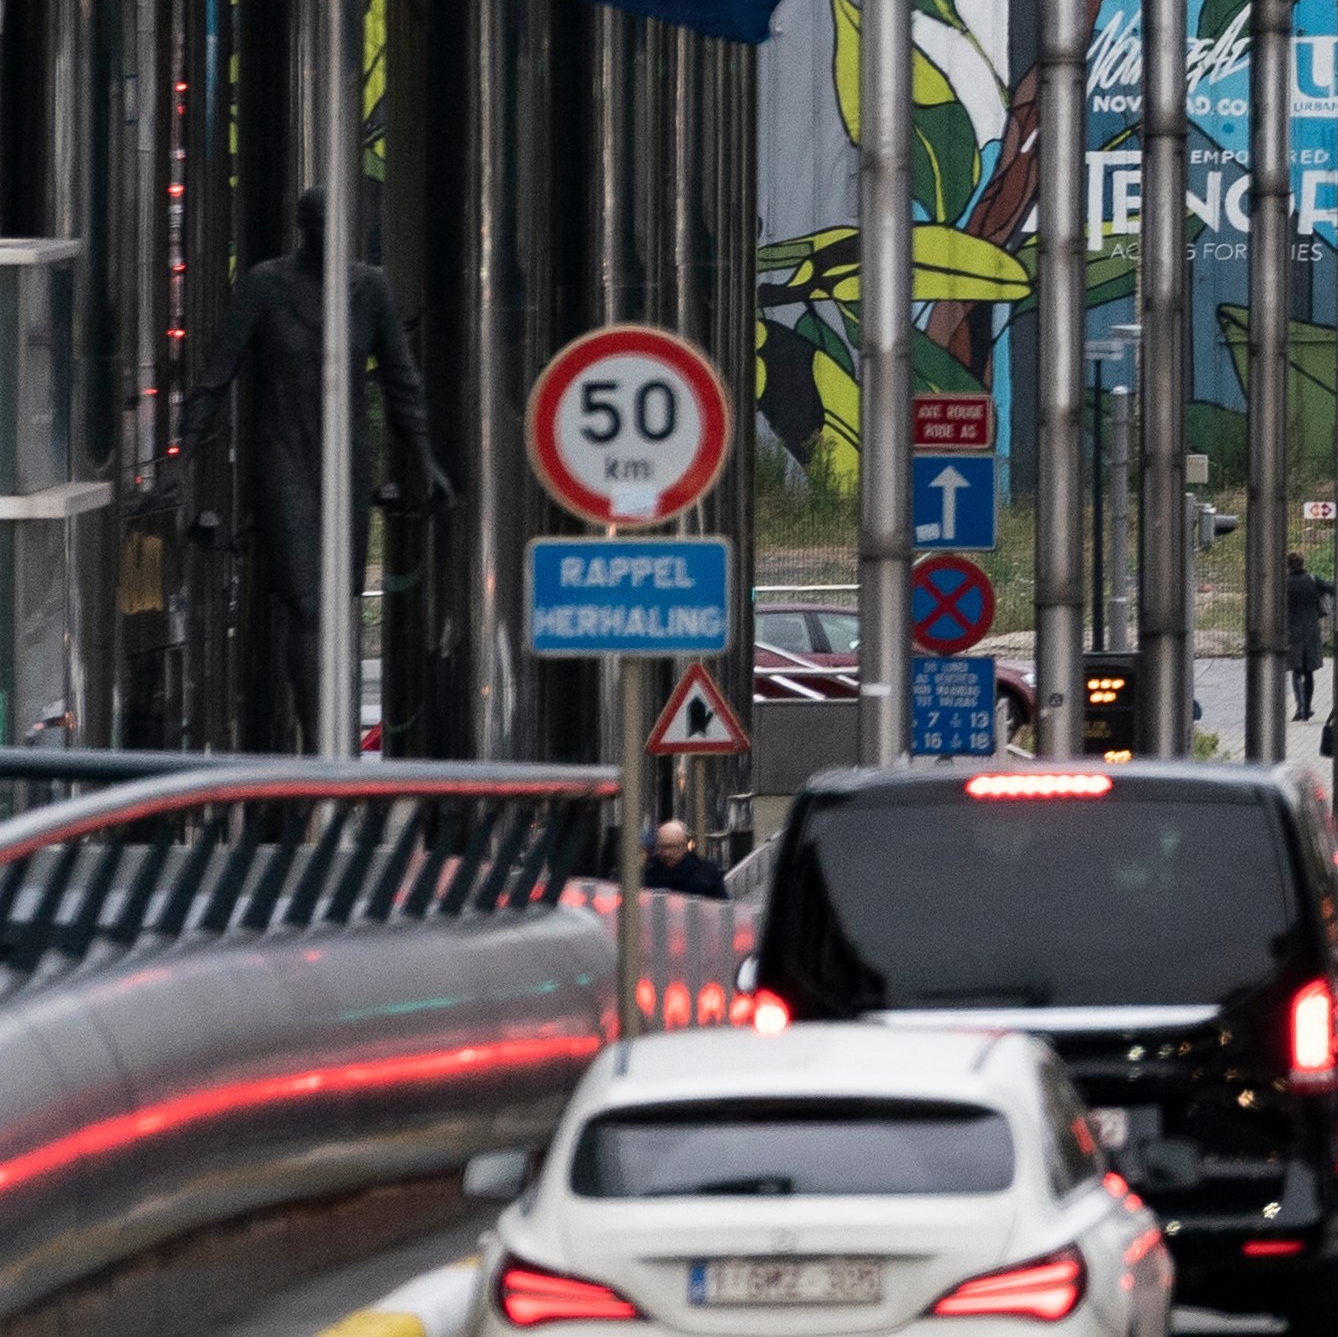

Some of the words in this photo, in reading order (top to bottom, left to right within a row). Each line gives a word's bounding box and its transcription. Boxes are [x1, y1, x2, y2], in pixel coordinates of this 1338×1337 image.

[581, 380, 677, 443] 50
[604, 458, 653, 480] km
[560, 556, 696, 589] RAPPEL
[534, 605, 727, 638] HERHALING
